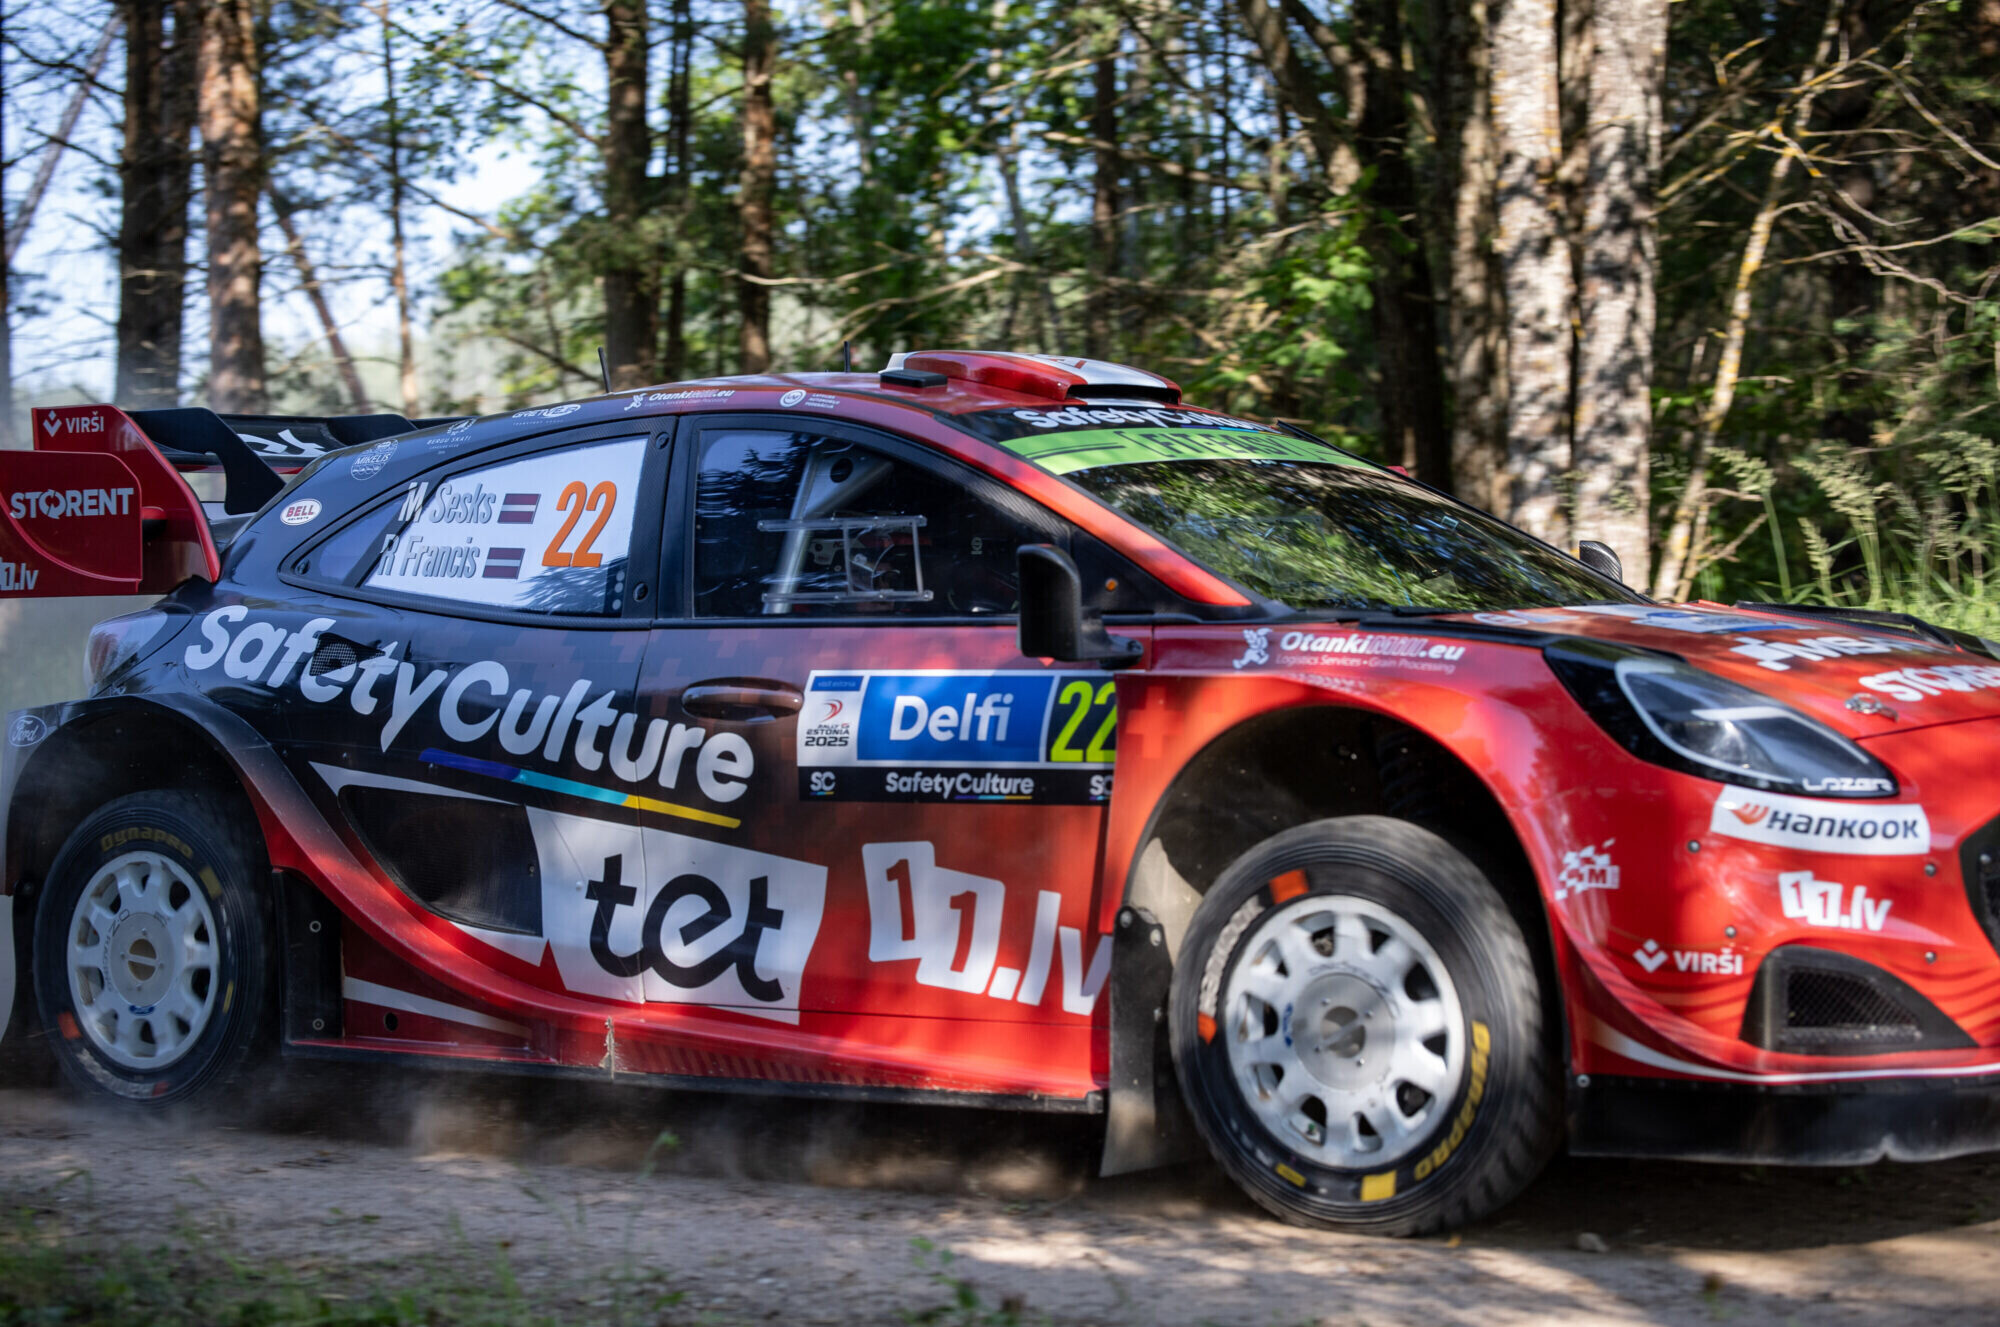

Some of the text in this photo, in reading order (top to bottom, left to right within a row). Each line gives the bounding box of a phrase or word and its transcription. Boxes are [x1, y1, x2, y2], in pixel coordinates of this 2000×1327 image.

[65, 411, 104, 433] VIRŠI
[10, 487, 134, 519] STORENT
[286, 505, 314, 518] BELL
[398, 482, 496, 524] M Sesks
[541, 481, 617, 567] 22
[378, 534, 480, 579] R Francis
[184, 605, 755, 803] SafetyCulture
[889, 693, 1014, 741] Delfi
[1051, 680, 1118, 763] 22
[804, 736, 849, 747] 2025
[810, 771, 836, 792] SC
[885, 772, 1035, 799] SafetyCulture
[1778, 870, 1892, 931] 11.lv
[585, 854, 784, 1002] tet
[862, 841, 1114, 1016] 11.lv
[1673, 947, 1743, 975] VIRŠI
